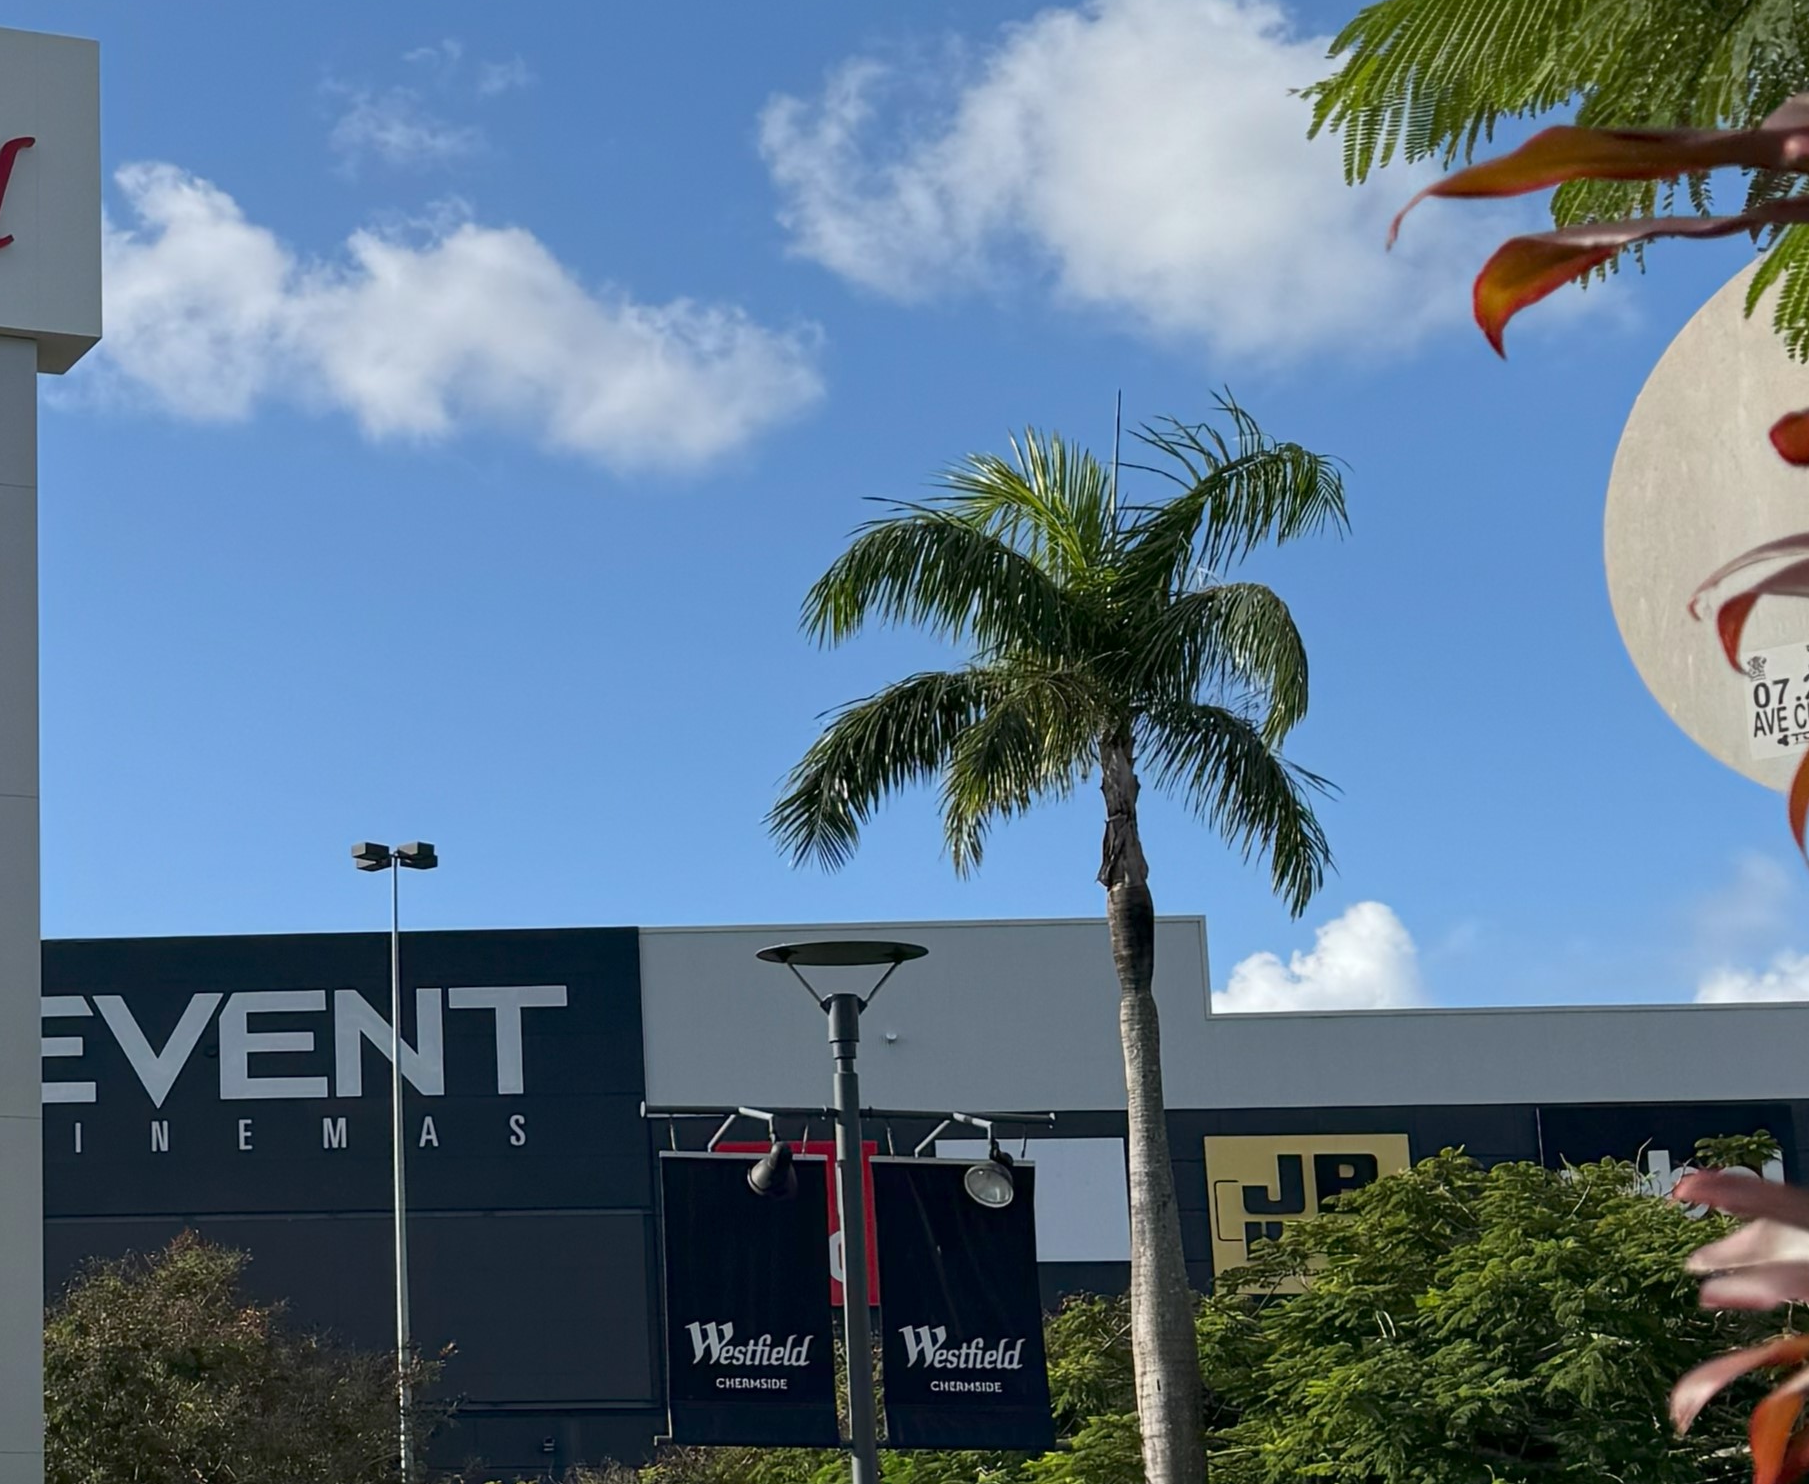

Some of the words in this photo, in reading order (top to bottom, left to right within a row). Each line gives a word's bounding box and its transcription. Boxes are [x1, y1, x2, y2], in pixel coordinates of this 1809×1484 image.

[1753, 705, 1789, 738] AVE
[74, 1114, 527, 1153] INEMAS
[685, 1321, 814, 1366] Westfield
[898, 1325, 1026, 1370] Westfield
[715, 1377, 788, 1390] CHERMSIDE
[929, 1380, 1003, 1393] CHERMSIDE
